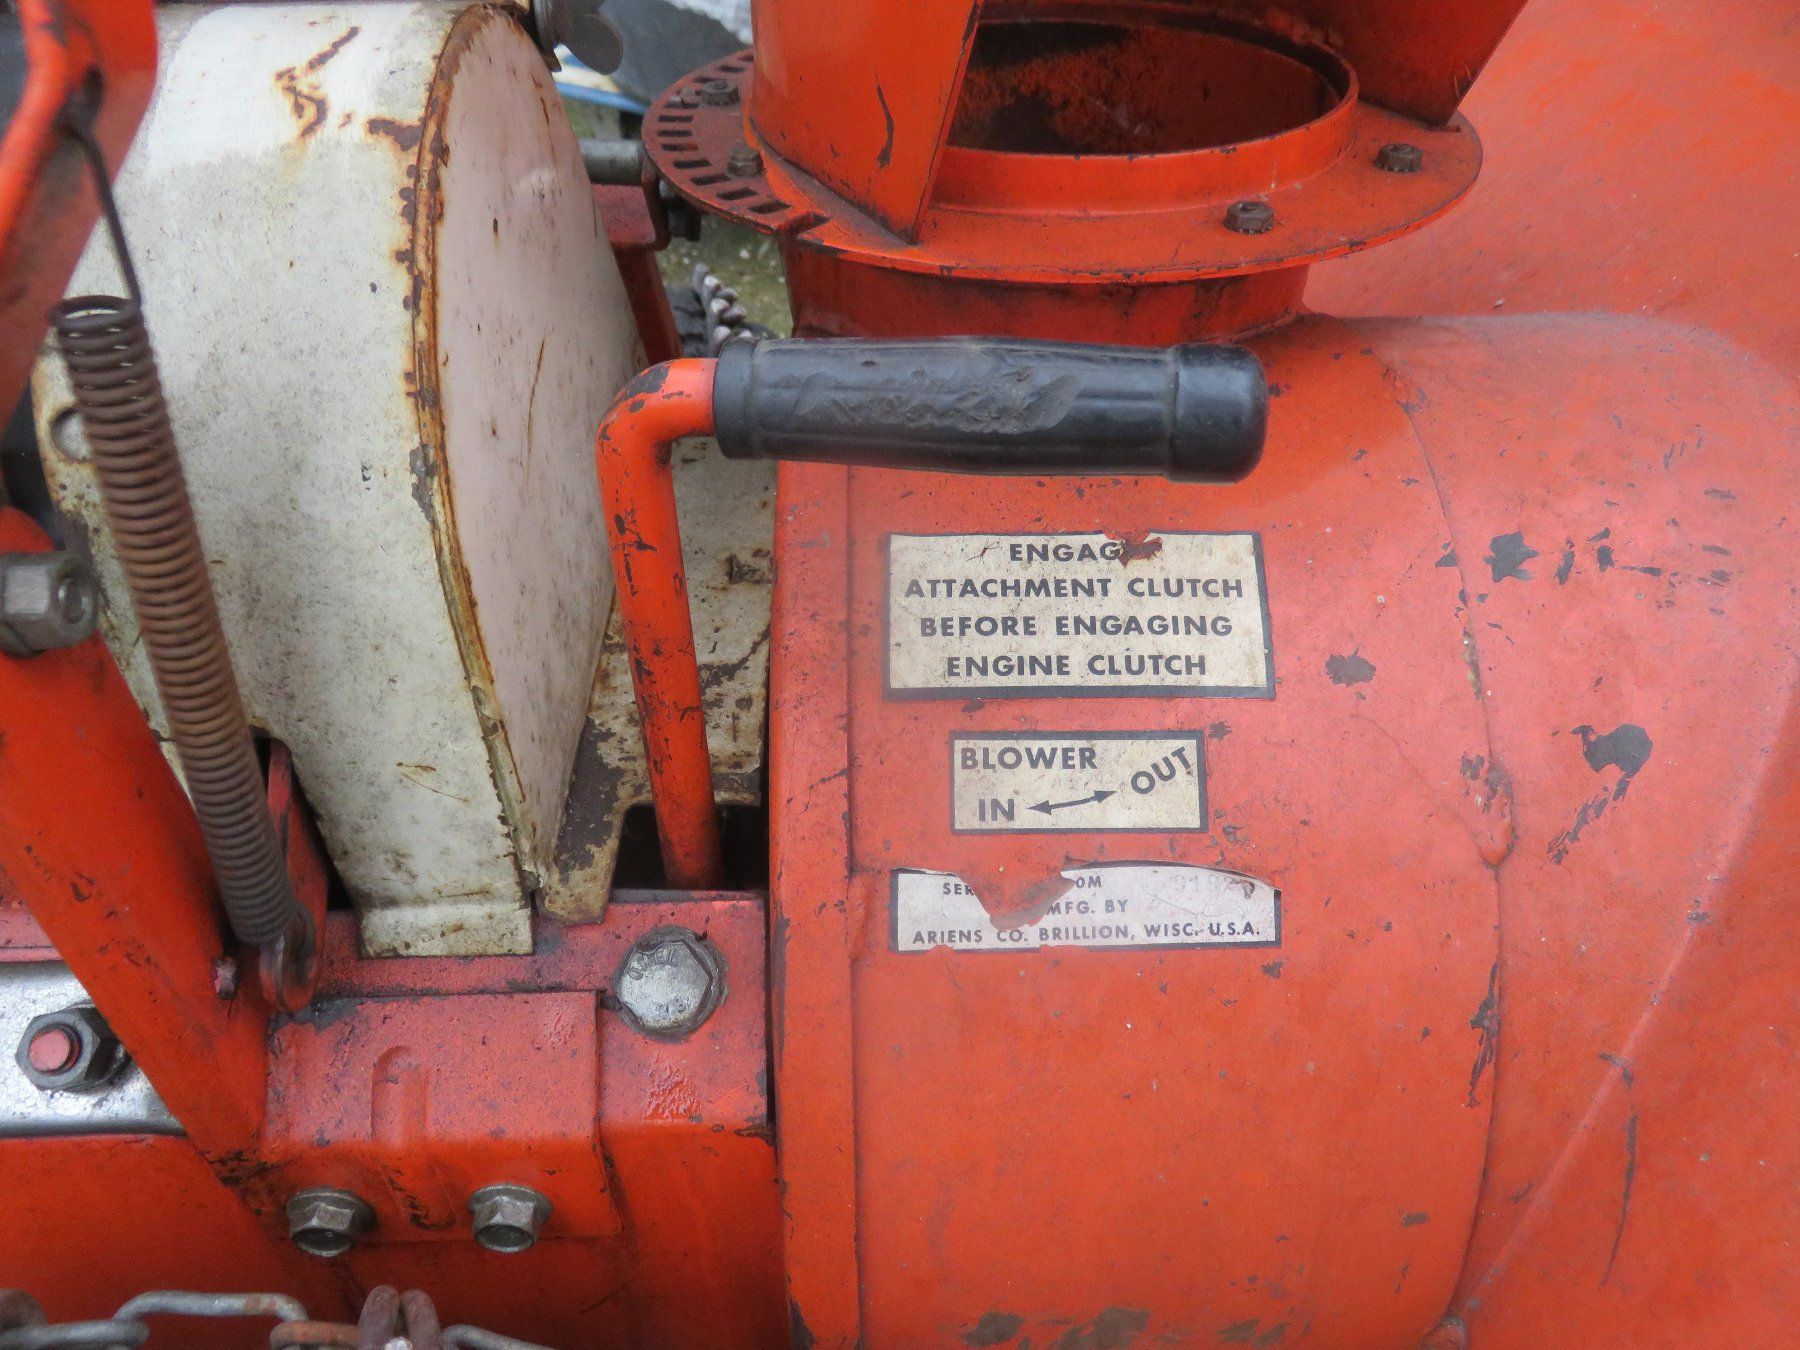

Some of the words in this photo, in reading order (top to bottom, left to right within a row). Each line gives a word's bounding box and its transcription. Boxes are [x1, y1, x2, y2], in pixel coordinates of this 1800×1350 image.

[1009, 542, 1127, 562] ENGAG
[905, 578, 1111, 598] ATTACHMENT
[1127, 577, 1243, 598] CLUTCH
[920, 616, 1037, 637] BEFORE
[1056, 615, 1233, 636] ENGAGING
[947, 655, 1070, 677] ENGINE
[1087, 654, 1206, 676] CLUTCH
[960, 747, 1098, 770] BLOWER
[1131, 746, 1192, 795] OUT
[978, 798, 1015, 822] IN
[1104, 899, 1128, 914] BY
[912, 929, 983, 944] ARIENS
[996, 928, 1028, 942] CO.
[1039, 924, 1135, 941] BRILLION,
[1144, 922, 1199, 938] WISC.
[1208, 921, 1261, 937] U.S.A.
